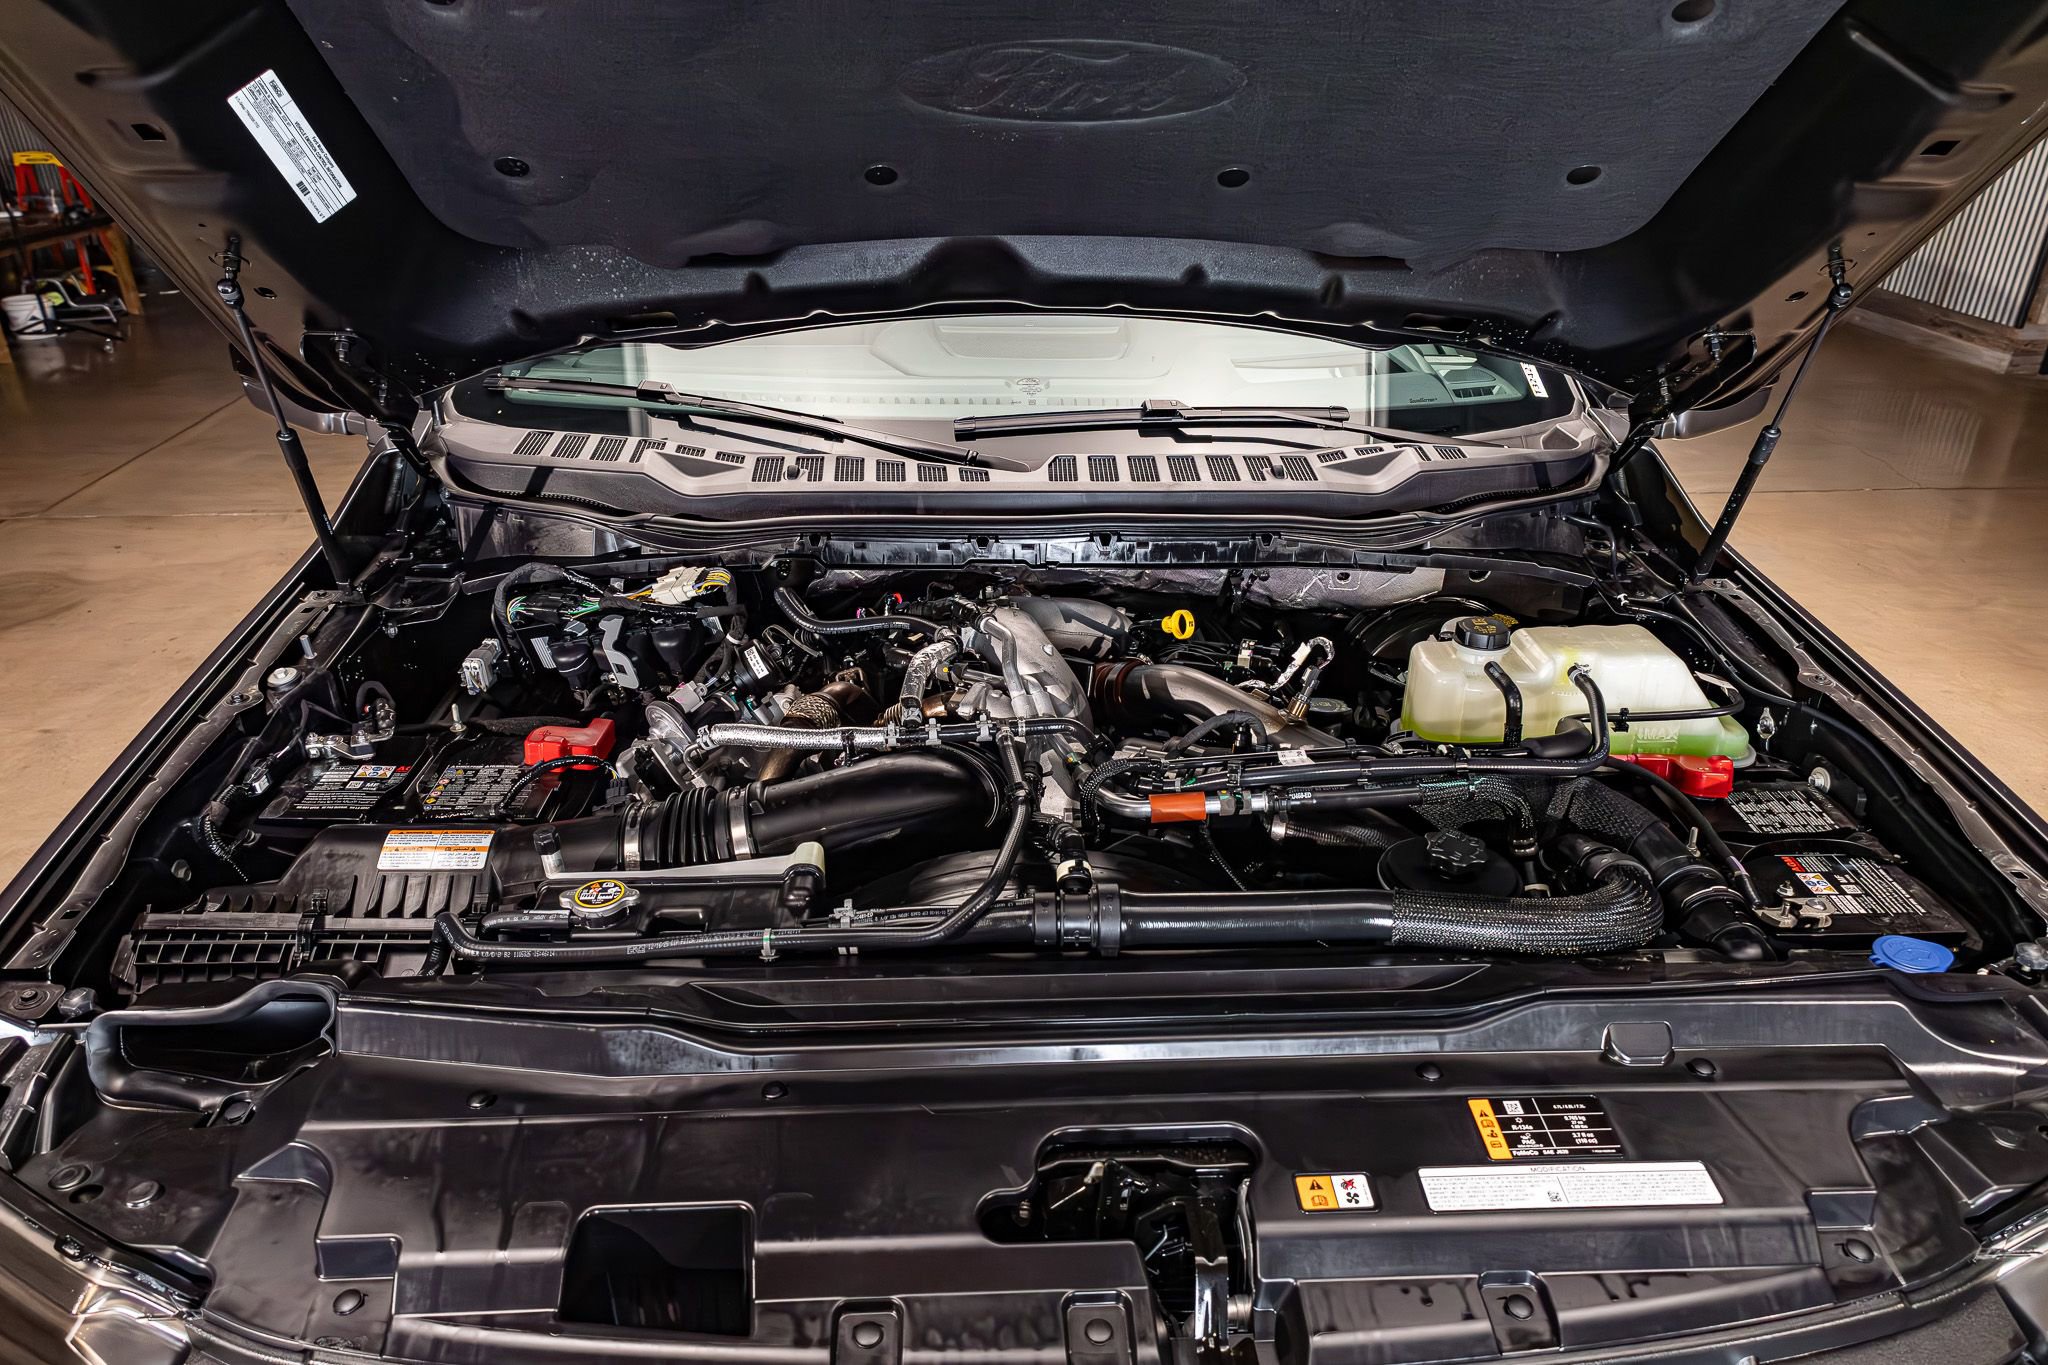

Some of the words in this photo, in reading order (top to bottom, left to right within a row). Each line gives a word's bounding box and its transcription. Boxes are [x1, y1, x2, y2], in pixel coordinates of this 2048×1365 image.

[953, 46, 1189, 114] Ford
[294, 121, 307, 136] VEHICLE
[304, 135, 318, 153] EMISSION
[315, 151, 328, 167] CONTROL
[326, 166, 342, 188] INFORMATION
[311, 136, 319, 145] Ford
[316, 144, 325, 154] Motor
[322, 153, 335, 169] Company
[1643, 727, 1678, 740] MAX
